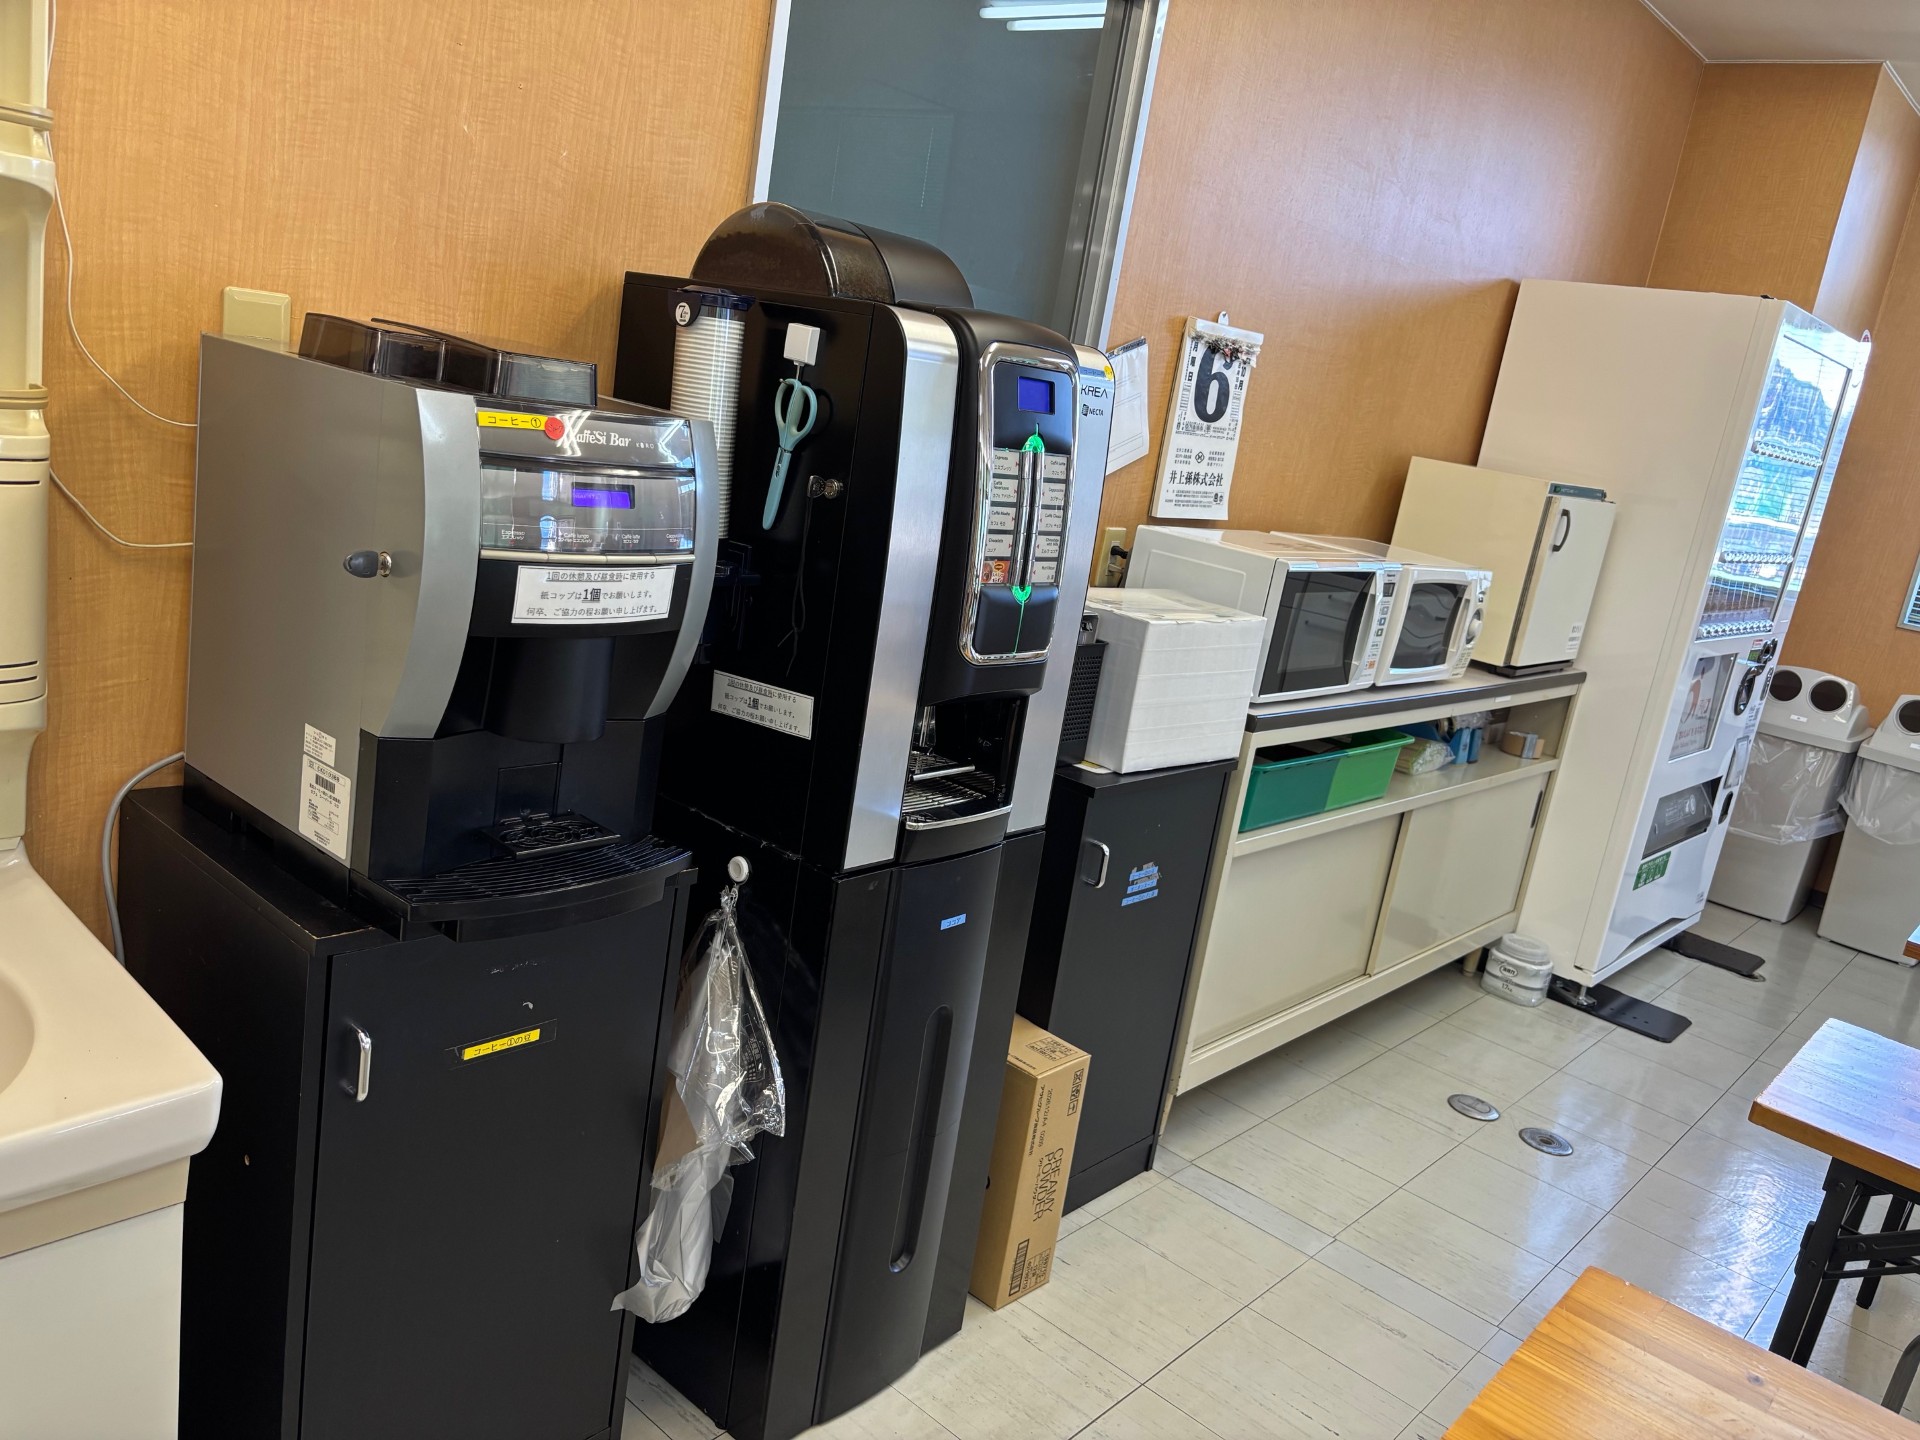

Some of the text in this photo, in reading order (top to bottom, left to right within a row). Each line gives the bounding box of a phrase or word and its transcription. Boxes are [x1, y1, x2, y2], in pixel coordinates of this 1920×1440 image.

[1081, 384, 1108, 399] KREA
[1194, 346, 1233, 423] 6
[487, 416, 541, 428] コーヒー①
[609, 432, 632, 447] Bar
[540, 587, 653, 601] 紙コップは1個でお願いします。
[473, 1033, 532, 1056] コーヒー①の豆
[1033, 1152, 1055, 1222] POWDER
[1043, 1147, 1064, 1212] CREAMY
